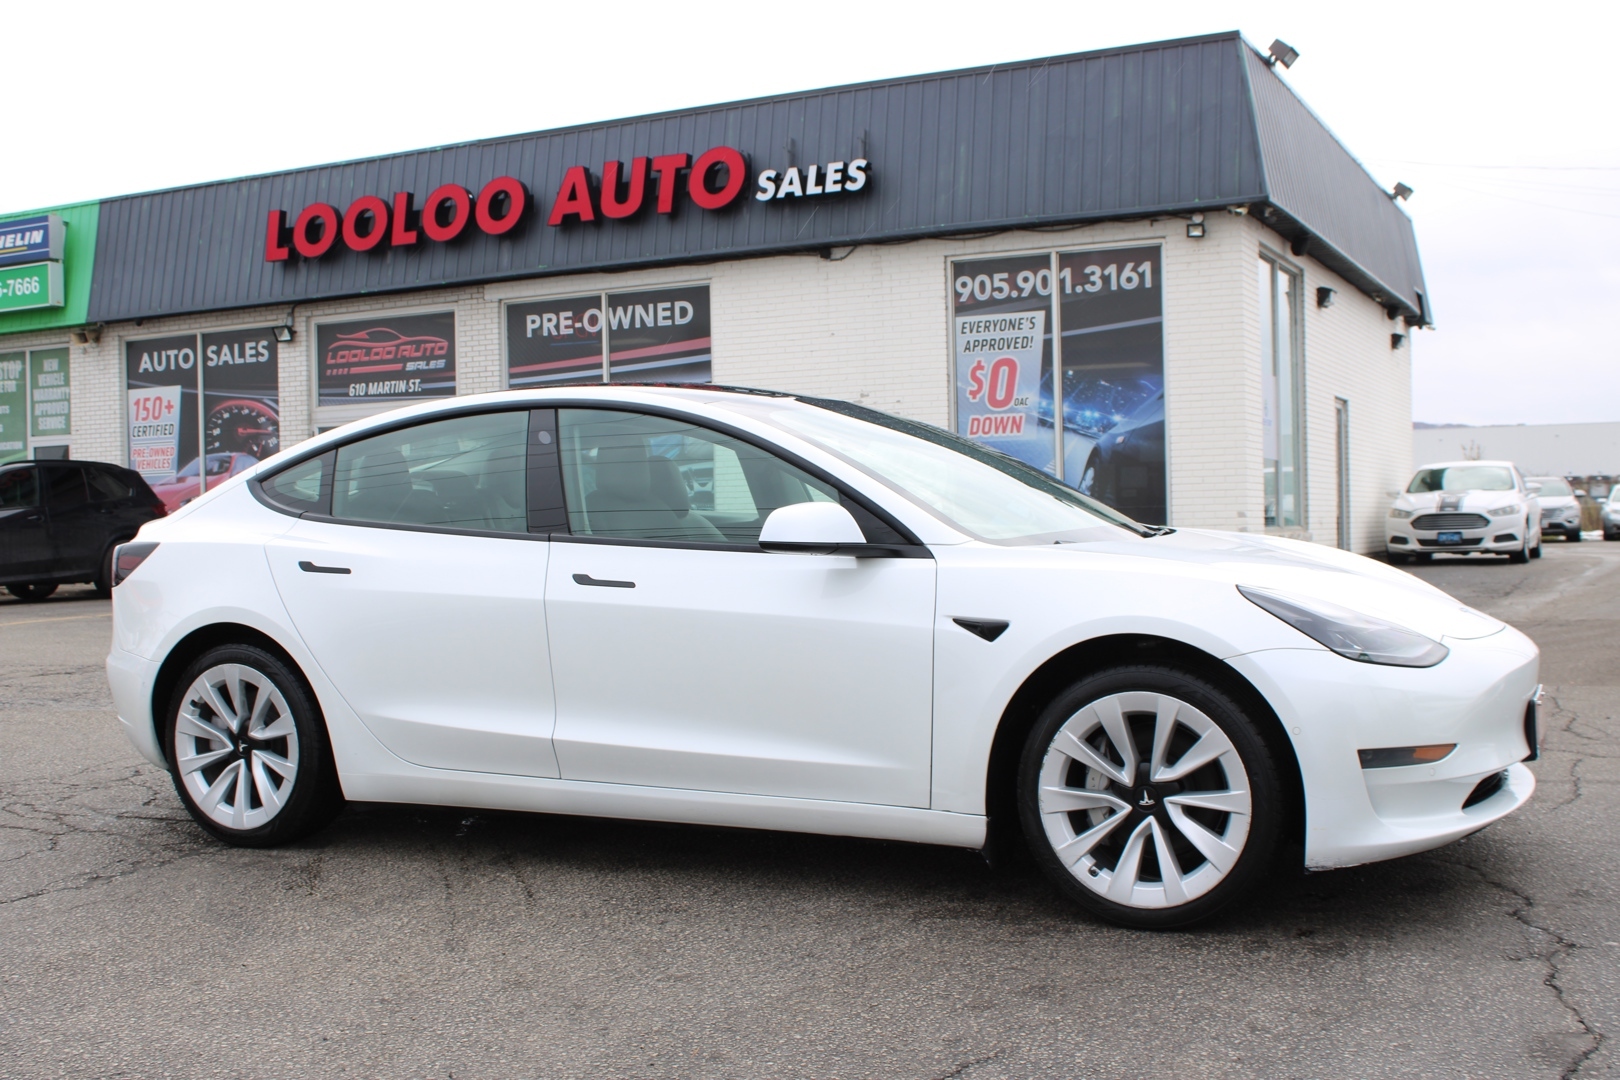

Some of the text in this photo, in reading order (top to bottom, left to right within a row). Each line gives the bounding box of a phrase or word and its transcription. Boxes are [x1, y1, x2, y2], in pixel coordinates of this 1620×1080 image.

[265, 146, 868, 262] LOOLOO AUTO SALES
[955, 261, 1153, 303] 905.901.3161
[526, 301, 694, 338] PRE-OWNED
[960, 317, 1037, 336] EVERYONE'S
[326, 342, 449, 365] LOOLOO AUTO
[963, 336, 1034, 354] APPROVED!
[138, 340, 270, 373] AUTO SALES
[405, 359, 447, 372] SALES
[38, 372, 65, 388] VEHICLE
[348, 379, 422, 397] 610 MARTIN ST.
[967, 357, 1029, 410] $0 OAC
[33, 386, 70, 402] WARRANTY
[34, 401, 69, 416] APPROVED
[133, 395, 175, 422] 150+
[38, 415, 66, 430] SERVICE
[132, 423, 175, 438] CERTIFIED
[969, 415, 1024, 437] DOWN
[131, 446, 175, 459] PRE-OWNED
[137, 458, 171, 470] VEHICLES
